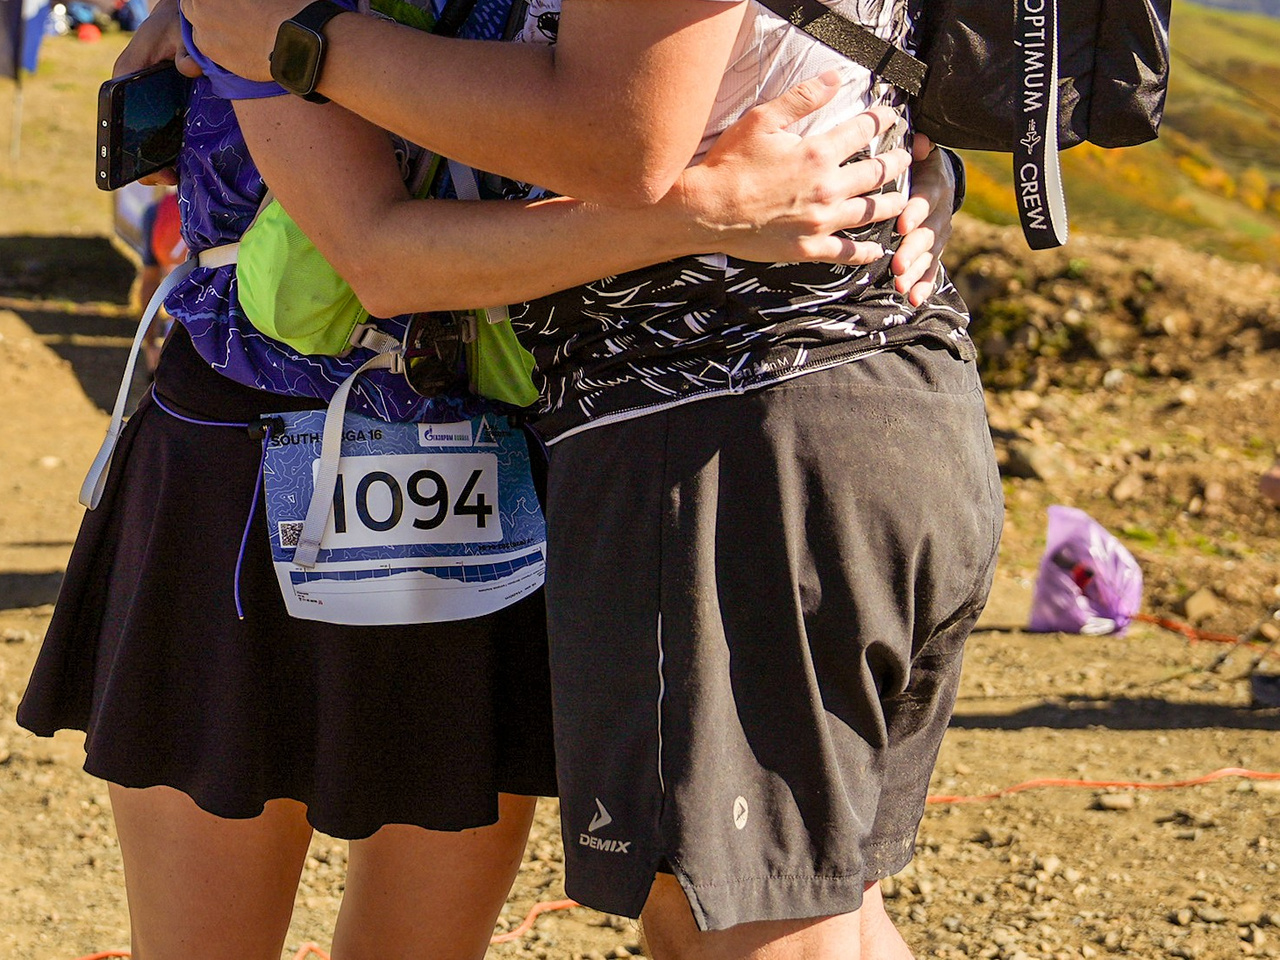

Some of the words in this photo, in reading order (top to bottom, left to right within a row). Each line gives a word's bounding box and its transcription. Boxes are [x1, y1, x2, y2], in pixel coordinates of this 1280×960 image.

[1019, 162, 1048, 230] CREW
[270, 432, 321, 447] SOUTH
[370, 429, 383, 441] 16
[332, 469, 493, 534] 1094
[579, 833, 632, 854] DEMIX
